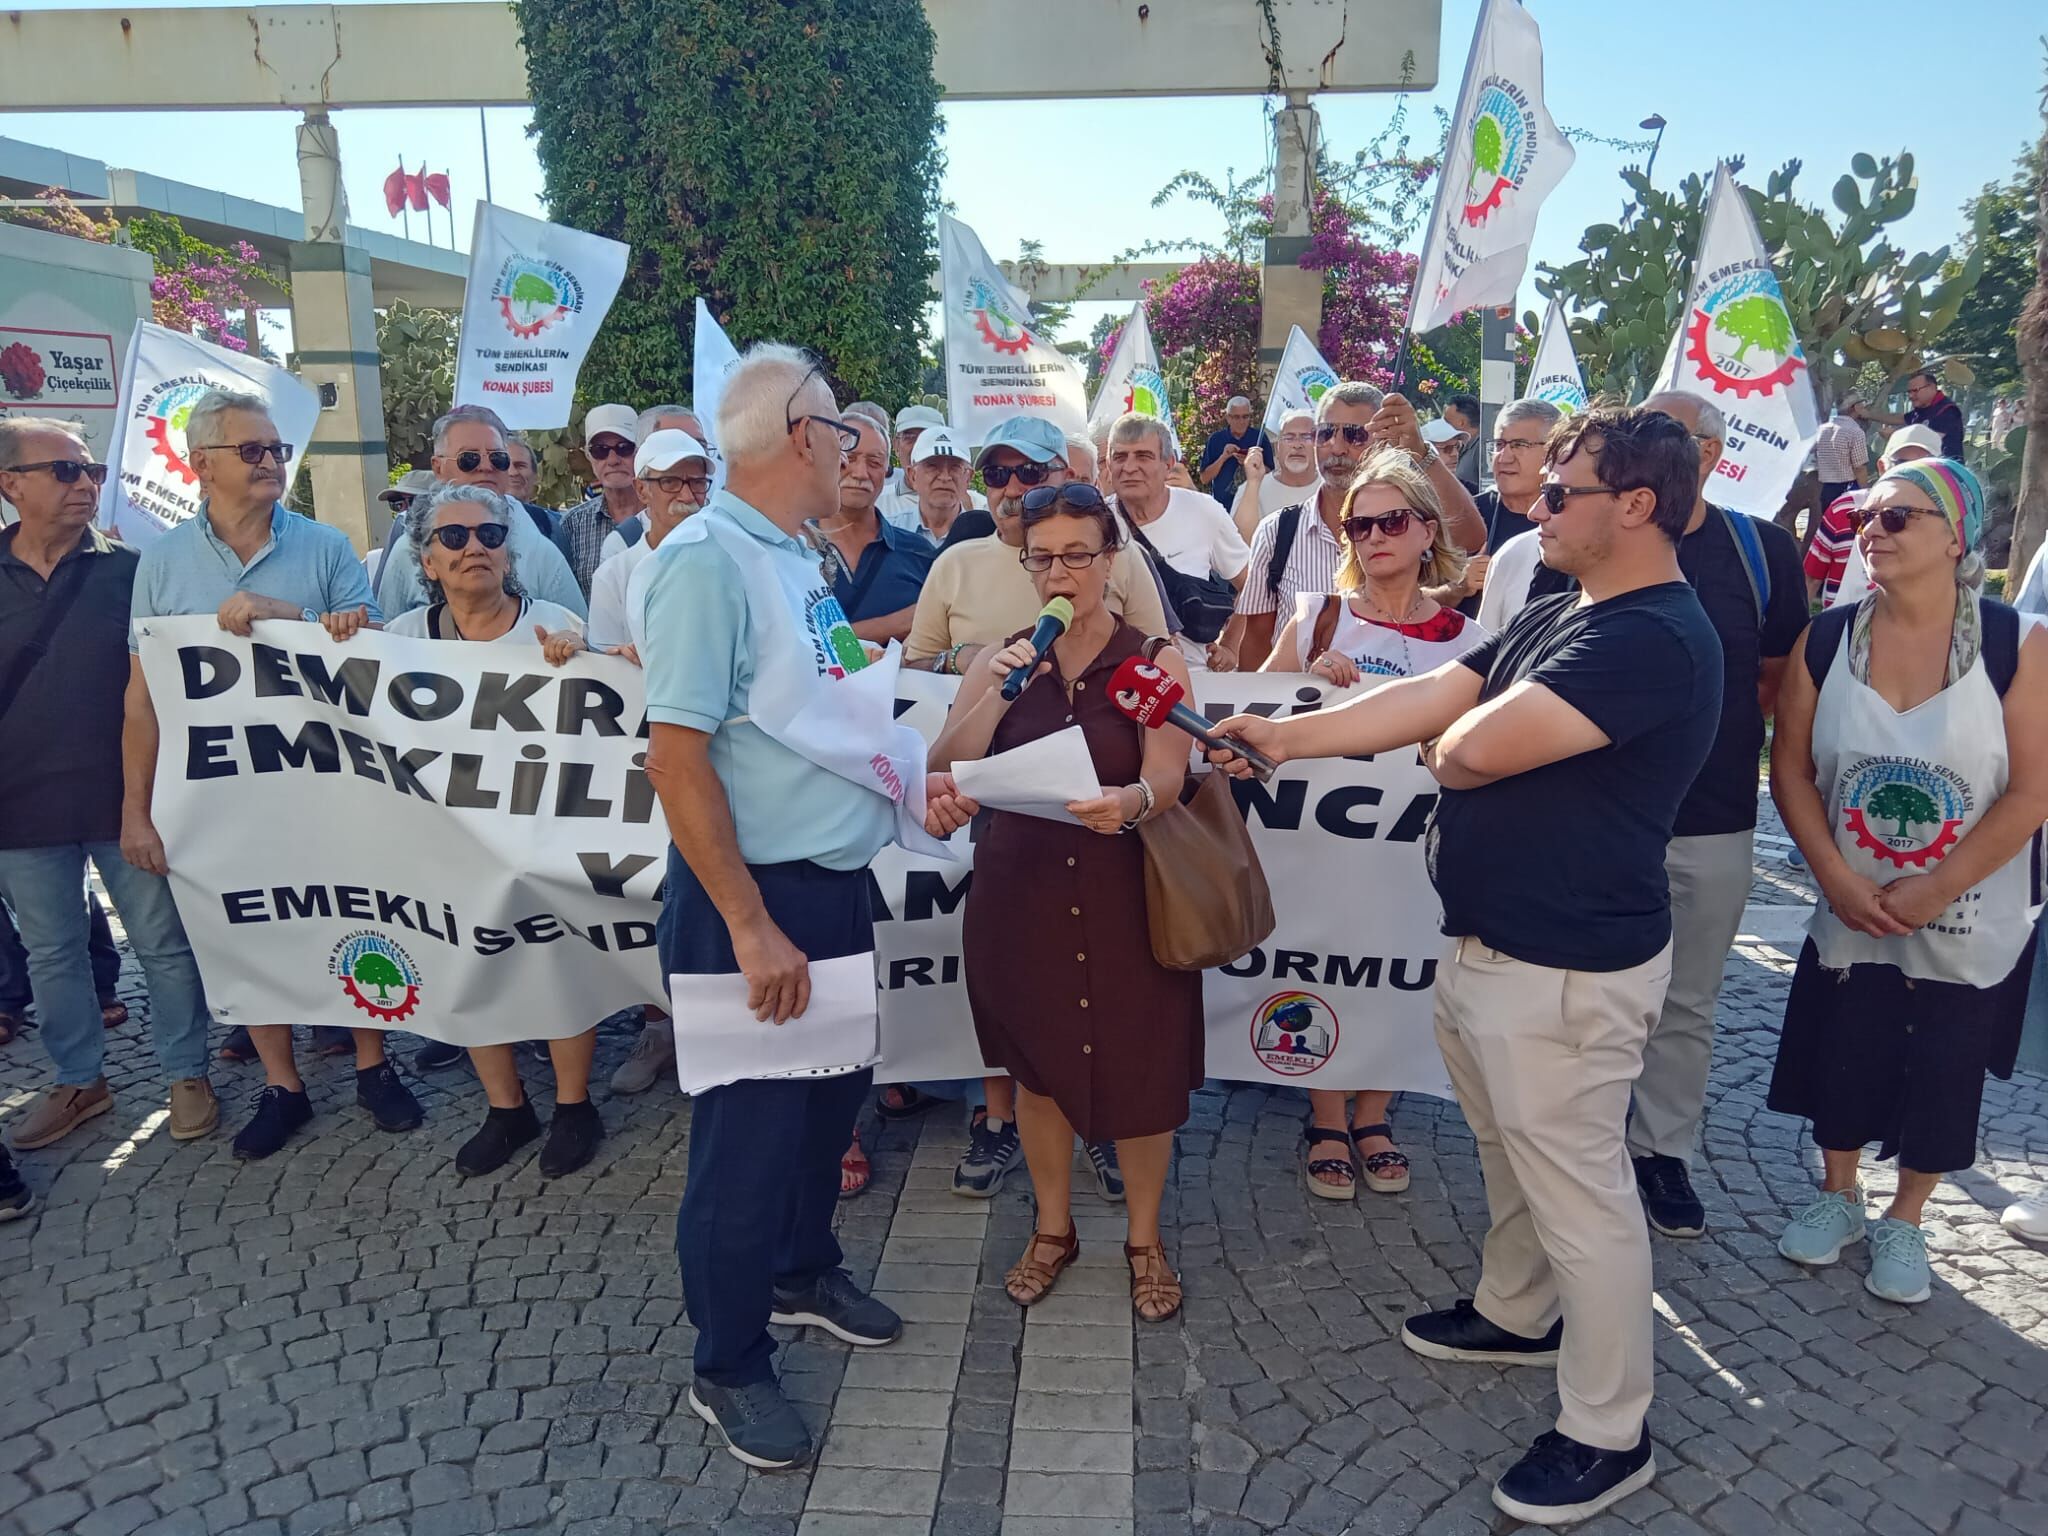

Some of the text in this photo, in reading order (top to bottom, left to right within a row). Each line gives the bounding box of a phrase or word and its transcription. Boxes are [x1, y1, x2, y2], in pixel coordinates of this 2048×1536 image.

[1512, 111, 1538, 191] SENDİKASI
[49, 350, 104, 375] Yaşar
[476, 347, 569, 360] TÜM EMEKLİLERİN
[495, 361, 547, 373] SENDİKASI
[959, 363, 984, 375] TÜM
[1715, 355, 1751, 379] 2017
[47, 376, 112, 394] Çiçekçilik
[482, 379, 553, 396] KONAK ŞUBESİ
[973, 393, 1015, 407] KONAK
[1715, 459, 1748, 482] ESİ
[177, 642, 650, 739] DEMOKR
[1136, 696, 1156, 723] anka
[1843, 754, 1931, 780] EMEKLİLERİN
[1932, 764, 1974, 812] SENDİKASI
[1887, 838, 1914, 848] 2017
[221, 884, 459, 947] EMEKLİ
[332, 929, 387, 954] EMEKLİLERİN
[877, 954, 960, 990] RI
[376, 999, 393, 1008] 2017
